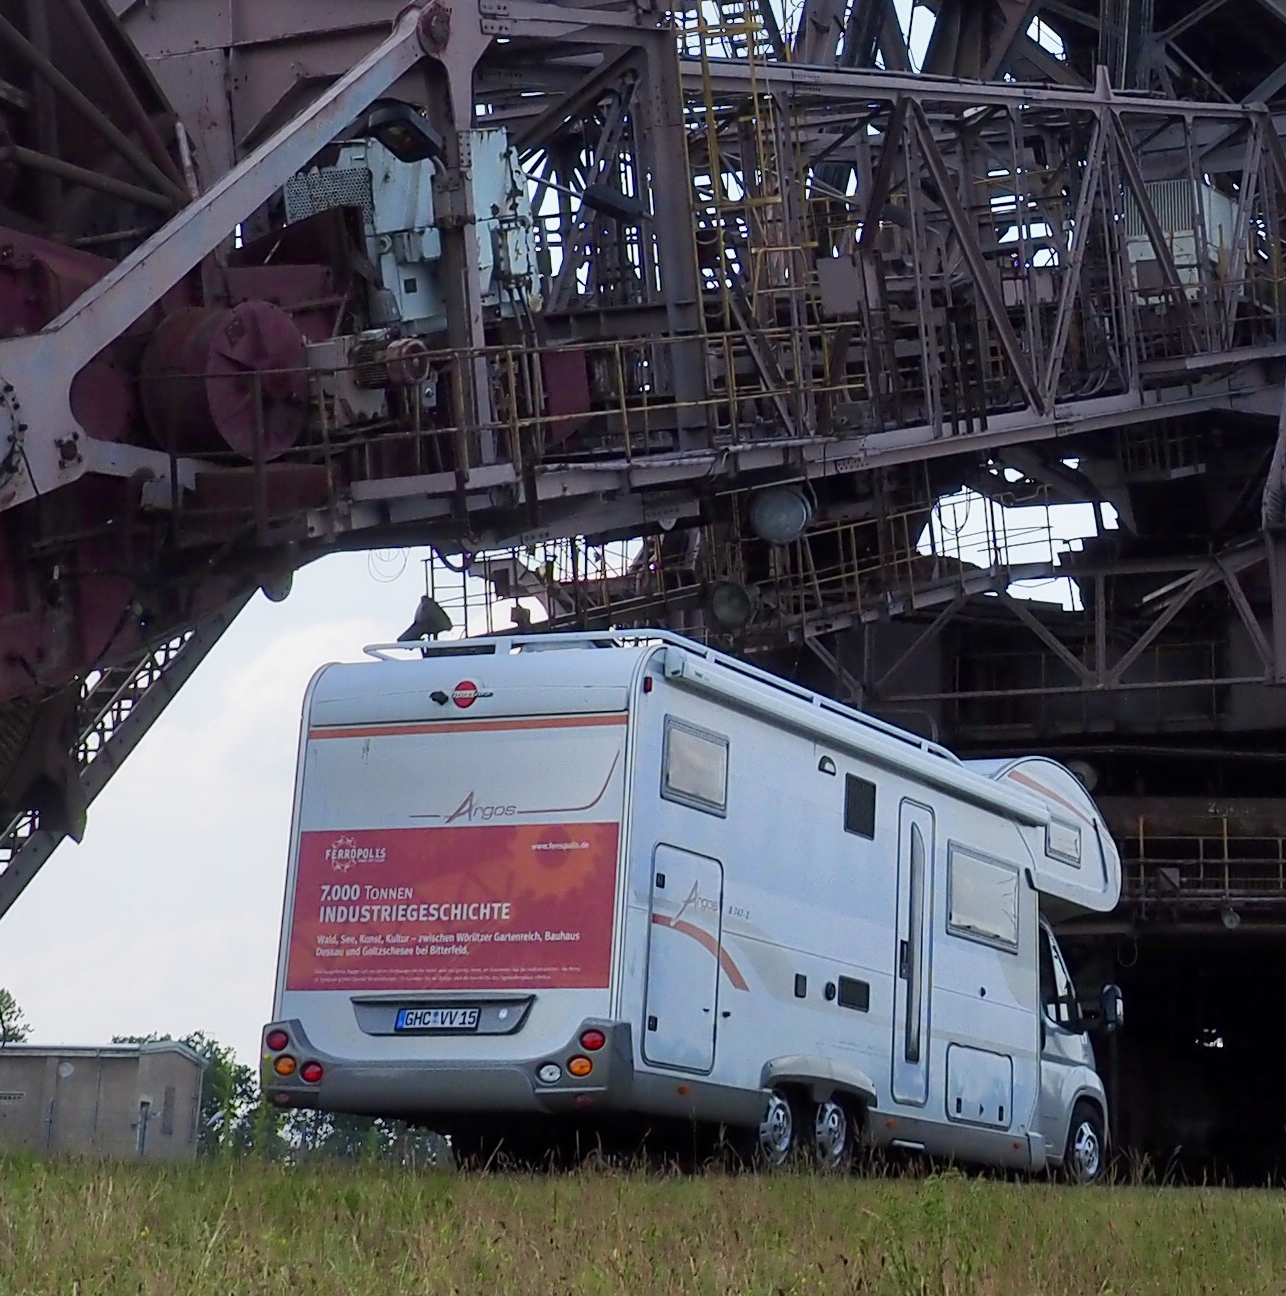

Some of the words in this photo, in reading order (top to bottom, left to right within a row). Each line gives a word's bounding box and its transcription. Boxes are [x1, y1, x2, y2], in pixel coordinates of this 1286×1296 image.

[445, 791, 517, 824] Argos
[325, 847, 387, 860] FERROPOLIS
[320, 884, 360, 901] 7.000
[319, 902, 511, 923] INDUSTRIEGESCHICHTE
[317, 934, 339, 945] Wald,
[340, 934, 358, 945] See,
[359, 933, 384, 944] Kunst,
[386, 933, 409, 943] Kultur
[418, 932, 454, 943] zwischen
[456, 931, 492, 943] Wörlitzer
[494, 931, 542, 942] Gartenreich,
[545, 930, 580, 941] Bauhaus
[316, 947, 344, 956] Dessau
[345, 946, 360, 956] und
[416, 944, 428, 955] bei
[430, 944, 469, 955] Bitterfeld.
[405, 1011, 431, 1025] GHC
[458, 1011, 477, 1025] 15
